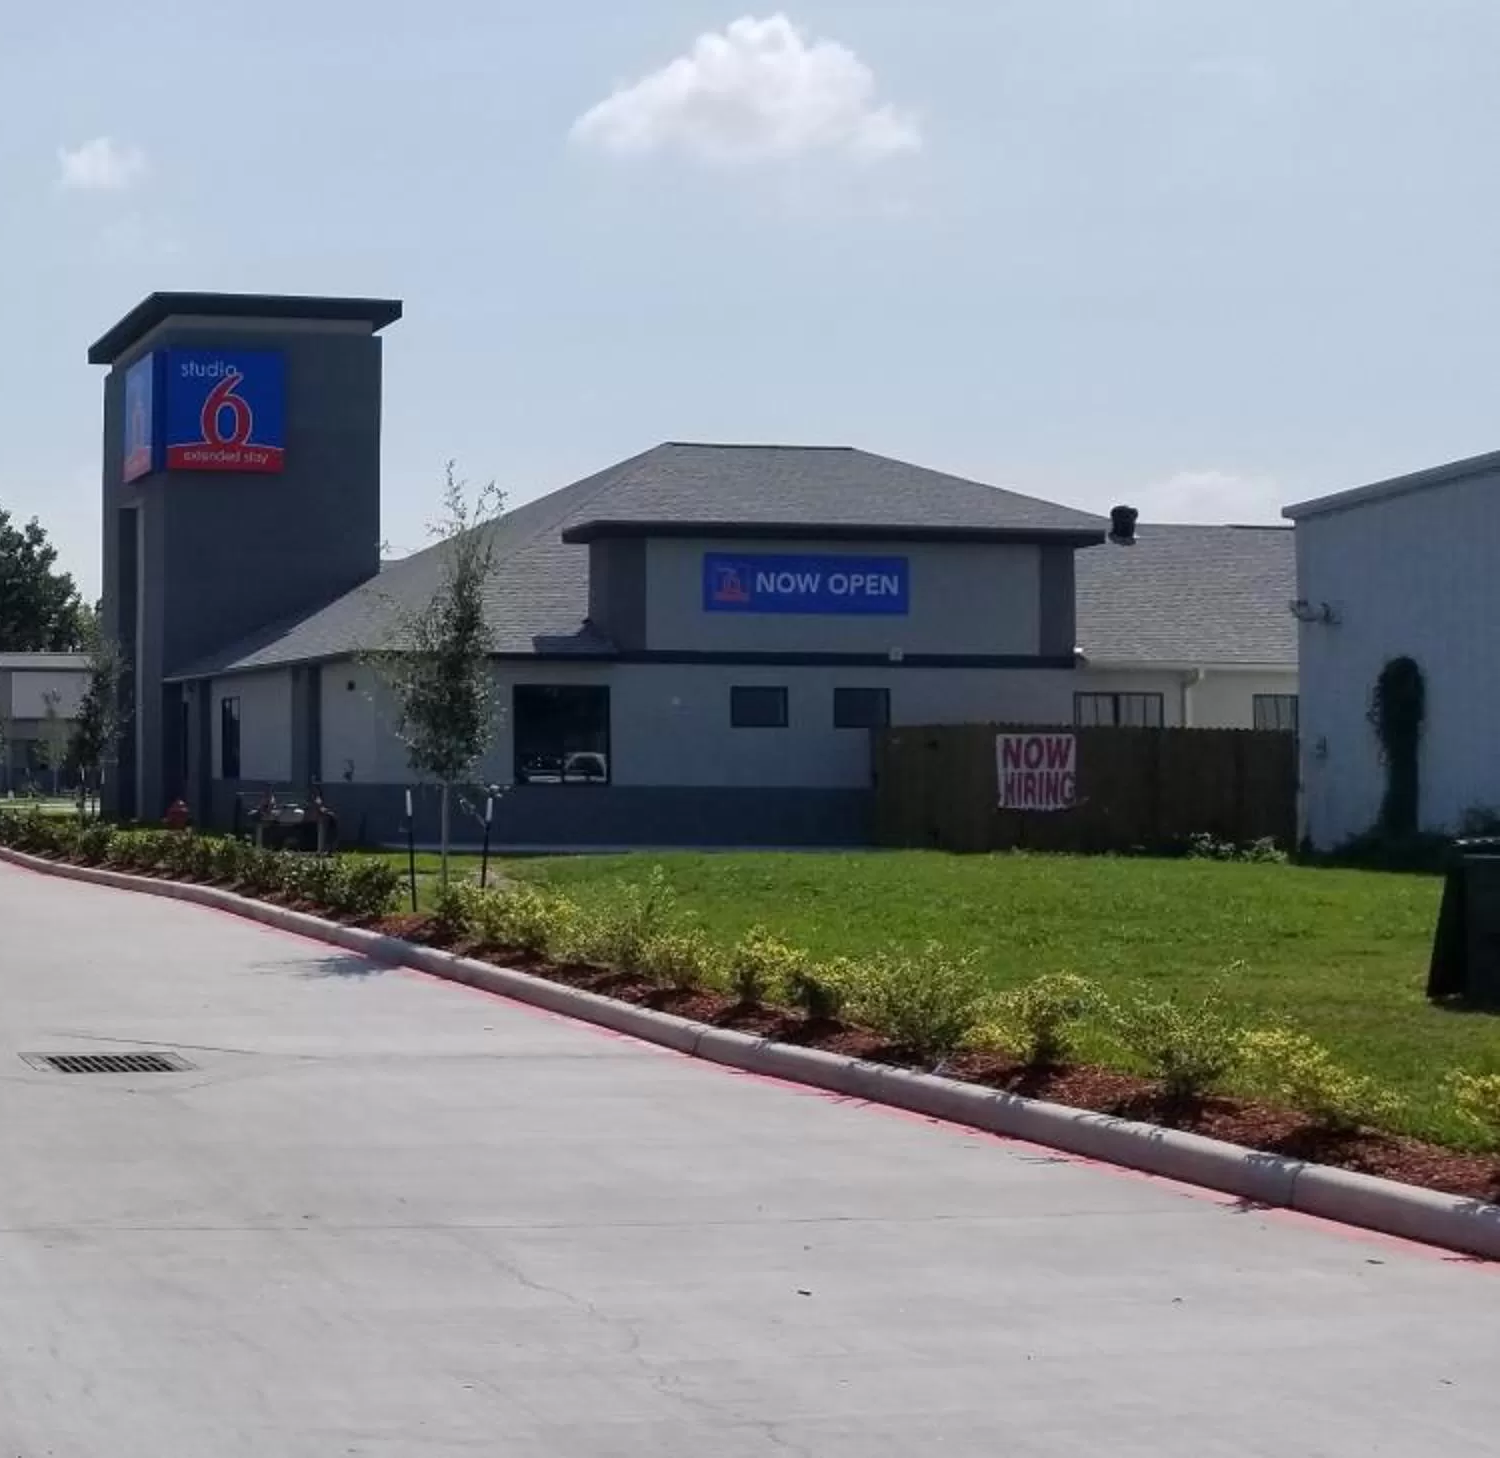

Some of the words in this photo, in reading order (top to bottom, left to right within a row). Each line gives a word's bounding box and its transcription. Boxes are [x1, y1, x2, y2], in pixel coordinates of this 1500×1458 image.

[180, 359, 237, 378] studio
[201, 371, 252, 446] 6
[183, 449, 241, 463] extended
[243, 451, 269, 465] stay
[755, 571, 821, 594] NOW
[827, 573, 899, 596] OPEN
[1003, 736, 1073, 769] NOW
[1004, 771, 1076, 806] HIRING
